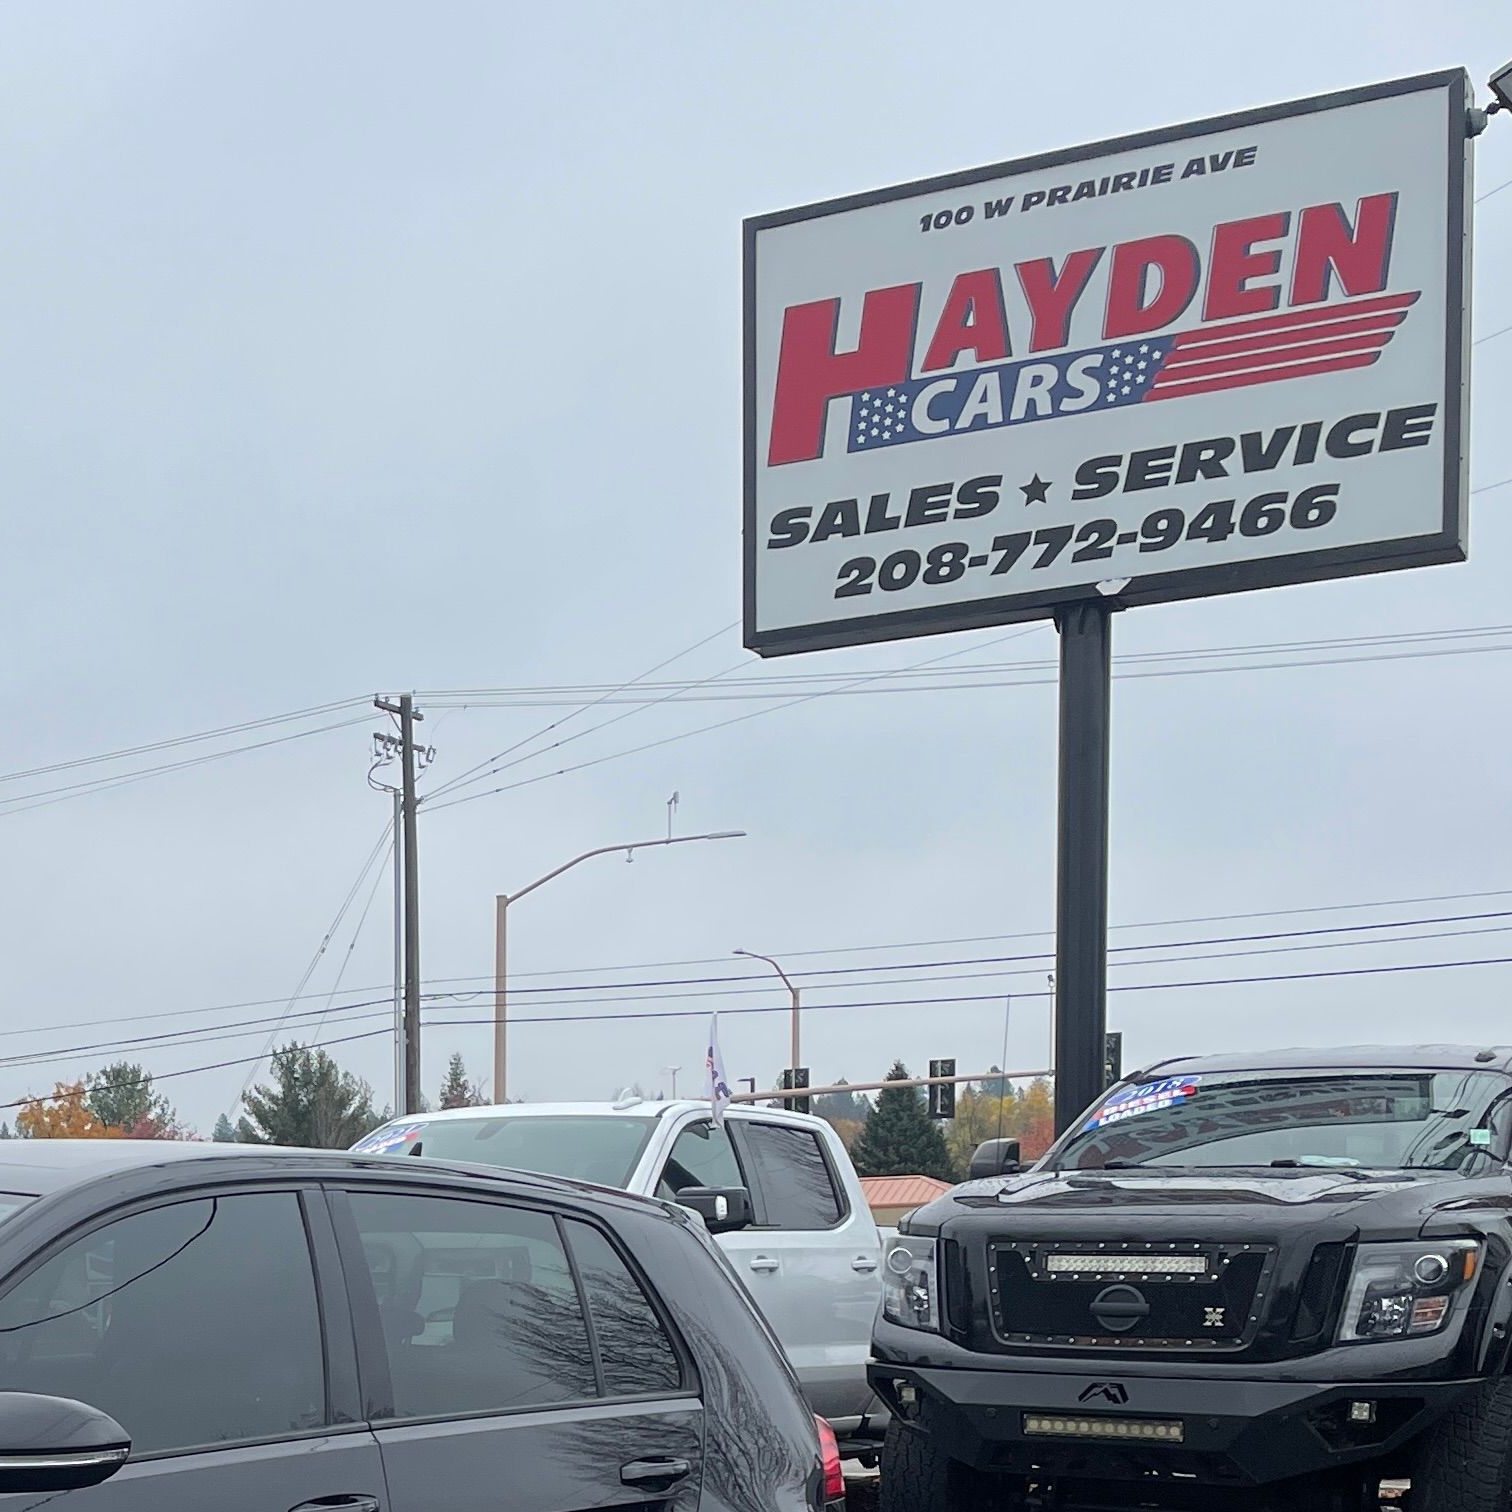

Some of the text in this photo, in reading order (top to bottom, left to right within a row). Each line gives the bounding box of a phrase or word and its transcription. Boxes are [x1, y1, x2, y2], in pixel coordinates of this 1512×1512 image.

[920, 145, 1259, 232] 100 W PRAIRIE AVE
[768, 191, 1399, 467] HAYDEN
[909, 353, 1105, 436] CARS
[767, 403, 1437, 549] SALES SERVICE
[834, 483, 1341, 599] 208-772-9466
[1097, 1099, 1172, 1127] LOADED
